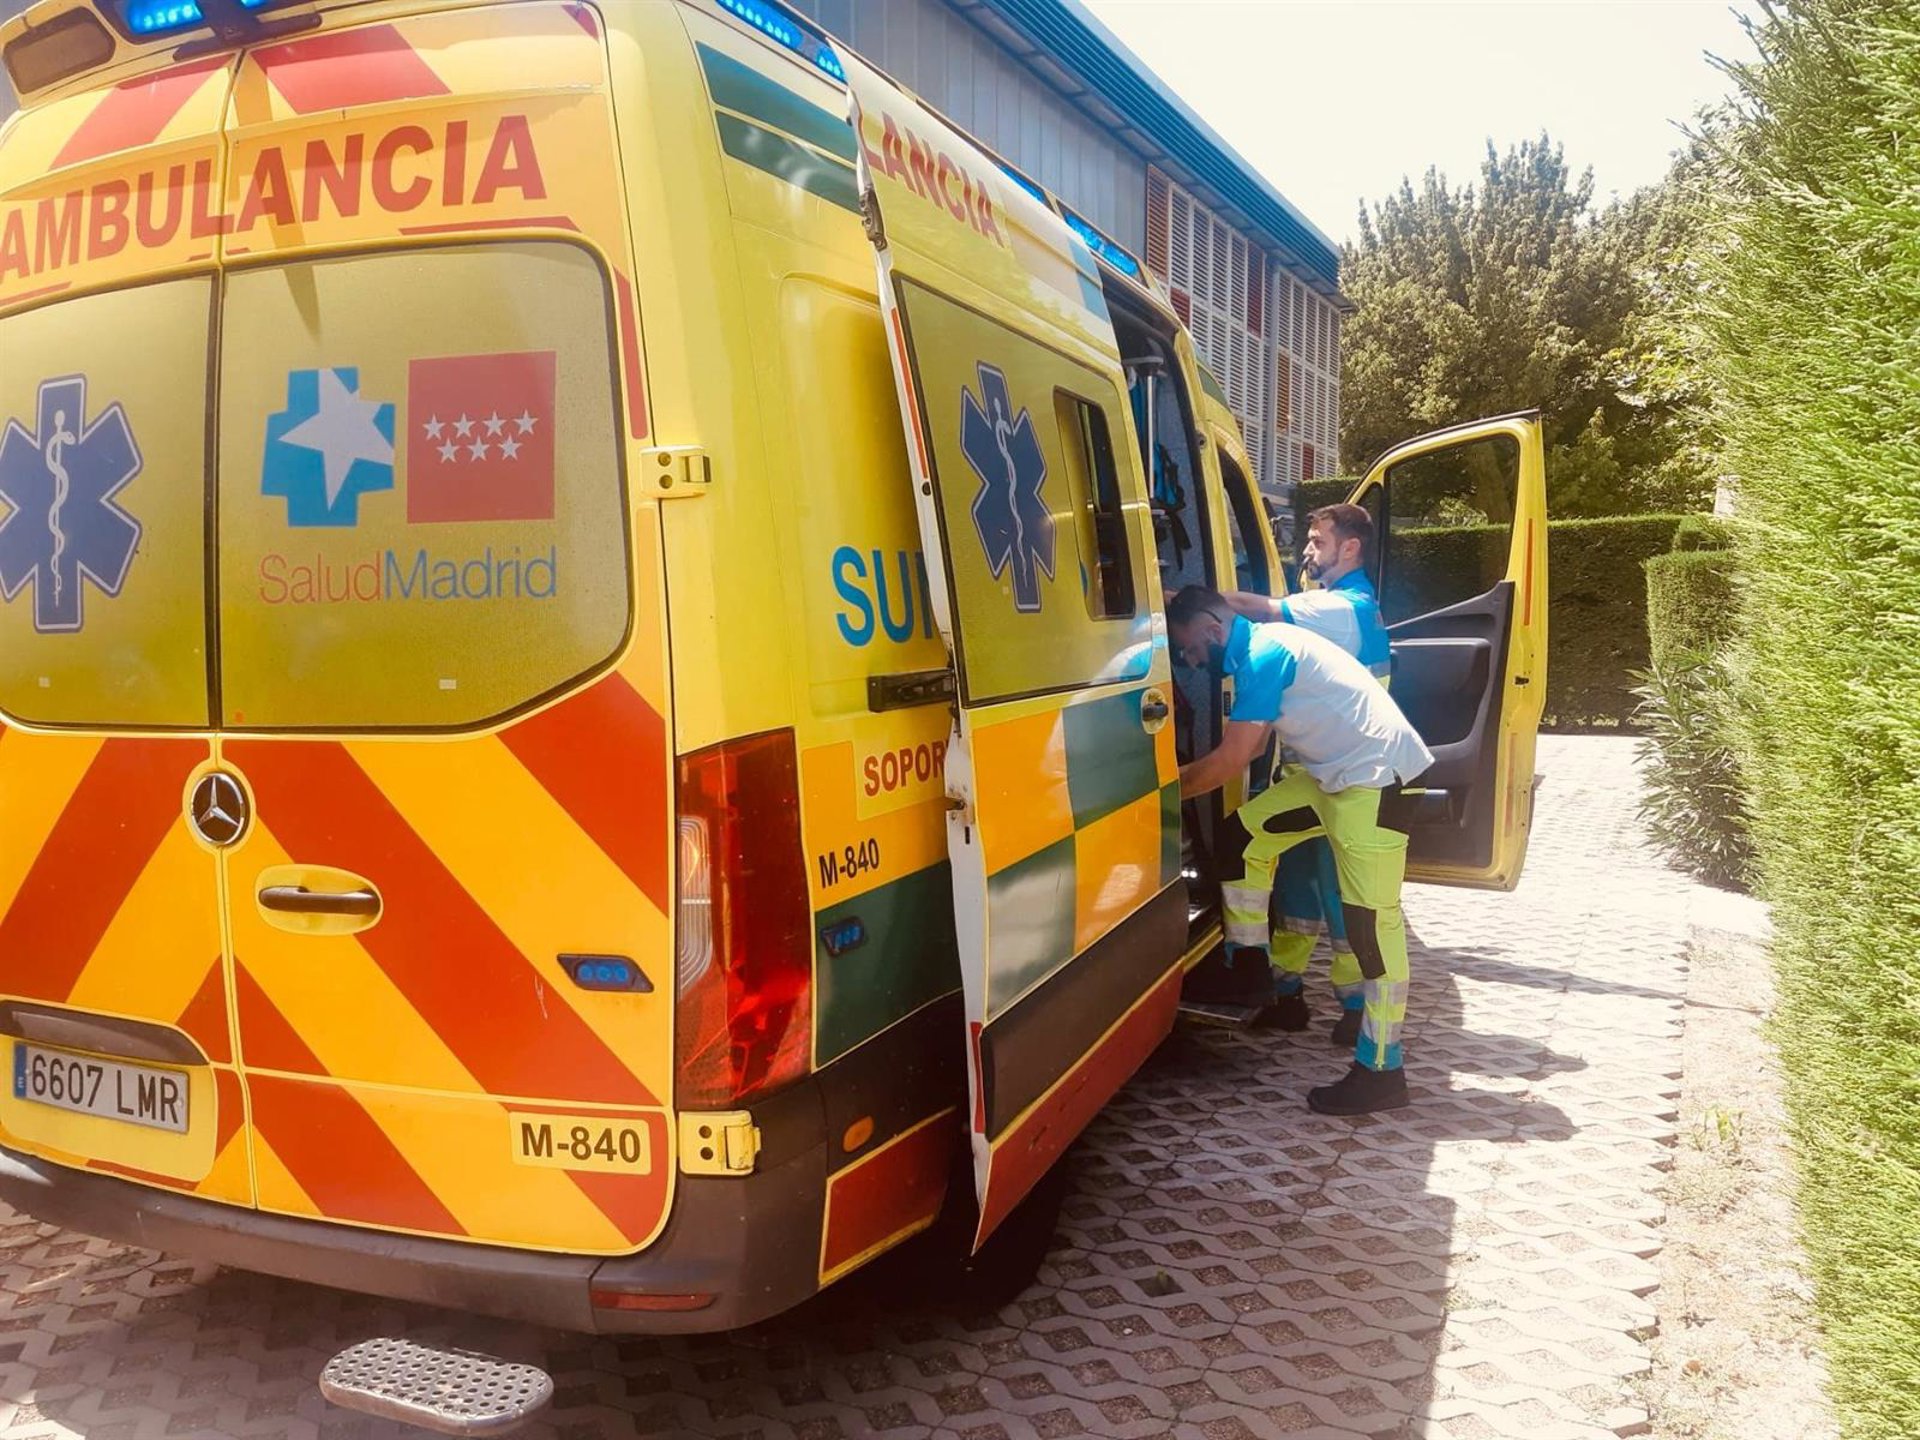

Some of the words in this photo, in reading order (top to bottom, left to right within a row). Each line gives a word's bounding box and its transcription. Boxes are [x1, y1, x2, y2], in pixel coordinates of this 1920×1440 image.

[0, 114, 549, 286] AMBULANCIA
[259, 546, 557, 604] SaludMadrid
[832, 545, 933, 647] SU
[863, 740, 950, 797] SOPOR
[818, 837, 880, 889] M-840
[32, 1053, 104, 1108] 6607
[116, 1069, 179, 1124] LMR
[521, 1122, 641, 1163] M-840
